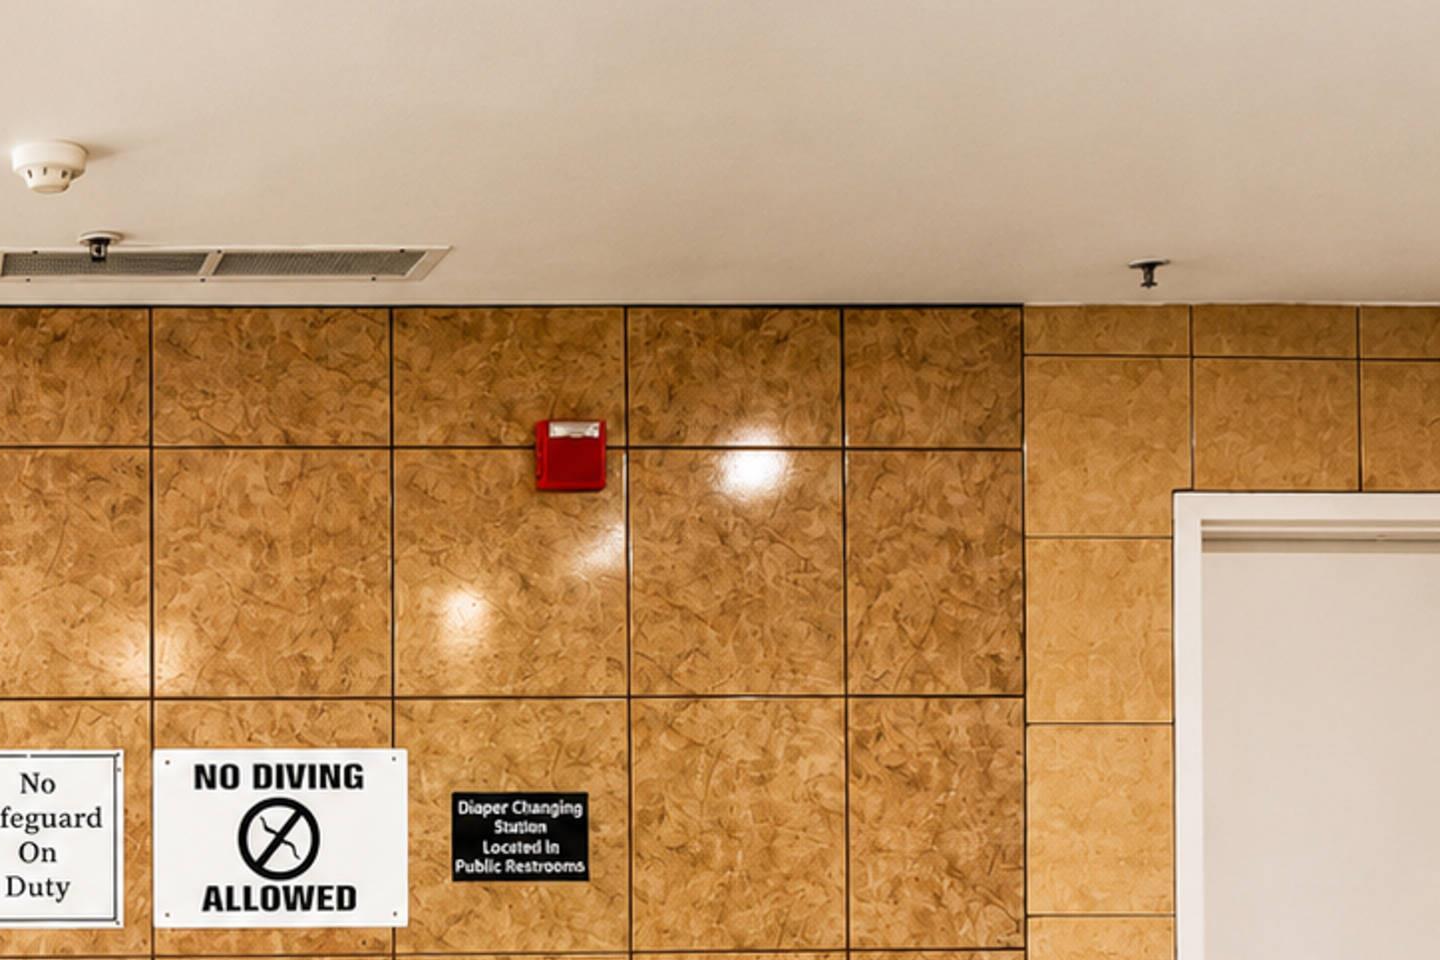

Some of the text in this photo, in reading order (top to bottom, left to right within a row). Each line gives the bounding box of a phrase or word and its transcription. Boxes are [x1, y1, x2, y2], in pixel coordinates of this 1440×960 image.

[20, 772, 56, 794] No
[194, 763, 364, 790] NO DIVING
[458, 799, 583, 819] Diaper Changing
[494, 819, 548, 834] Station
[18, 841, 57, 864] On
[482, 839, 560, 854] Located In
[455, 858, 585, 873] Public Restrooms
[5, 875, 70, 903] Duty
[202, 885, 357, 912] ALLOWED
